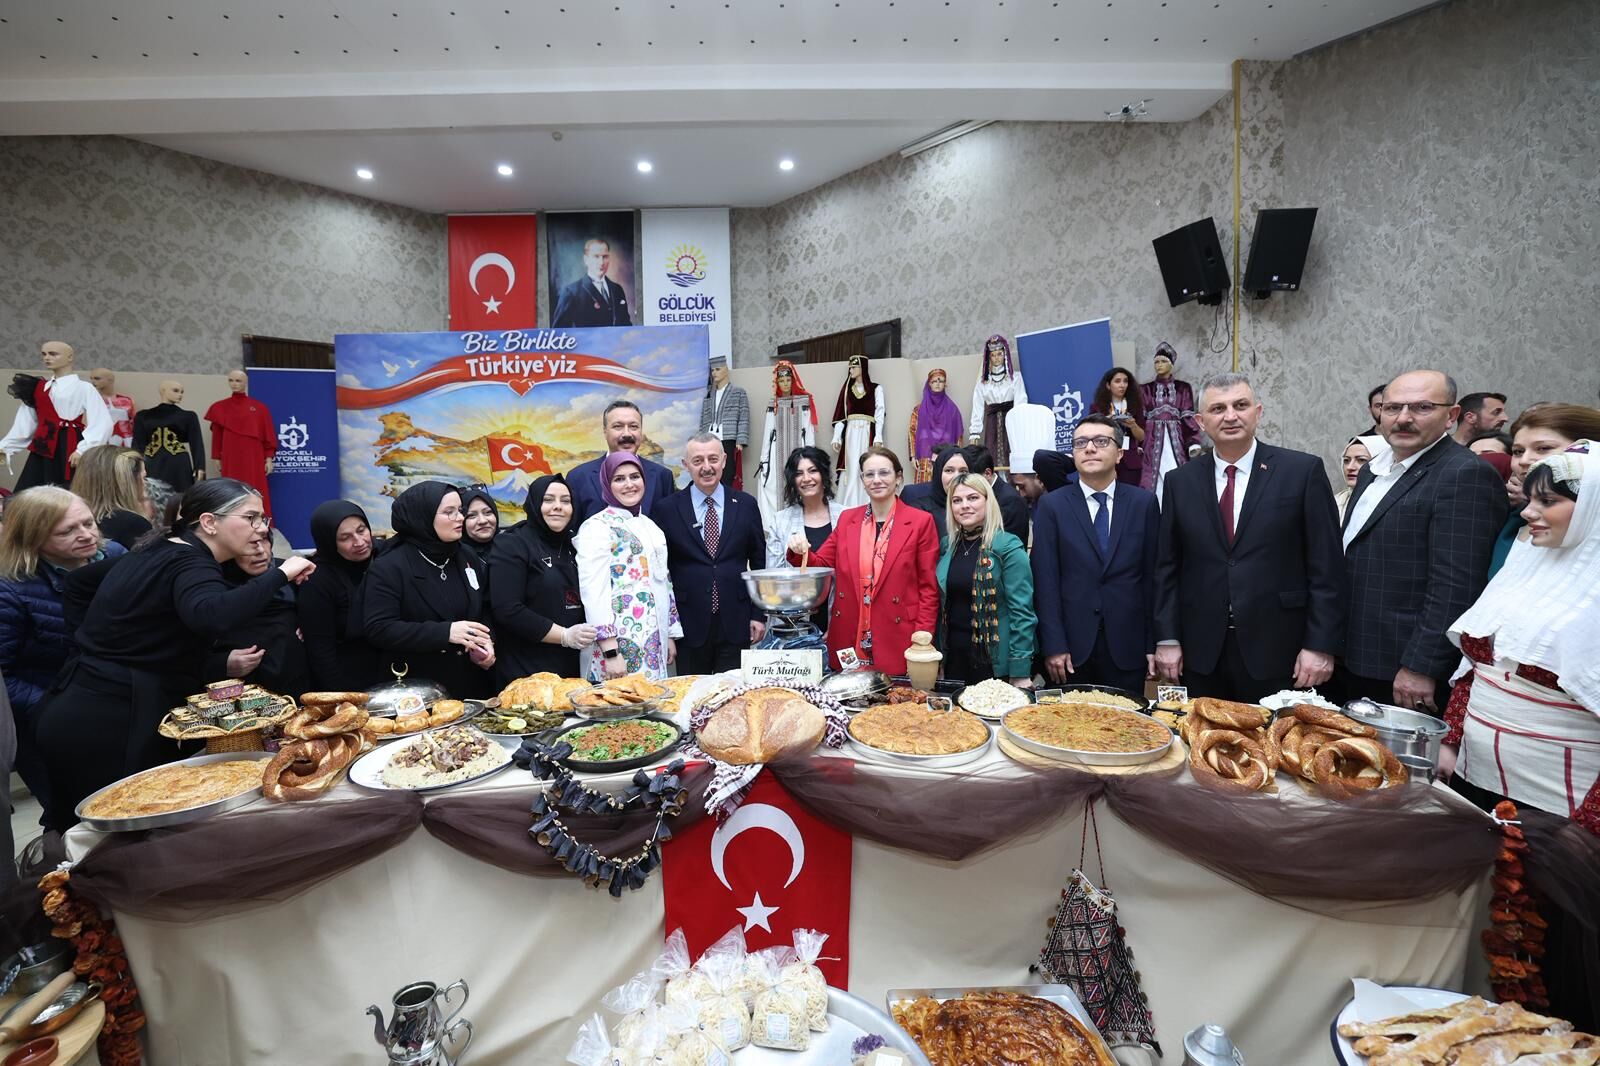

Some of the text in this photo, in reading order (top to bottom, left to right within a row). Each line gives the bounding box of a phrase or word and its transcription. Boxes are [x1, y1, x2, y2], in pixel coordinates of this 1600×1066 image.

[658, 293, 715, 310] GÖLCÜK
[659, 310, 716, 322] BELEDİYESİ
[460, 330, 577, 353] Biz Birlikte
[465, 355, 577, 377] Türkiye'yiz
[752, 666, 811, 676] Türk Mutfağı
